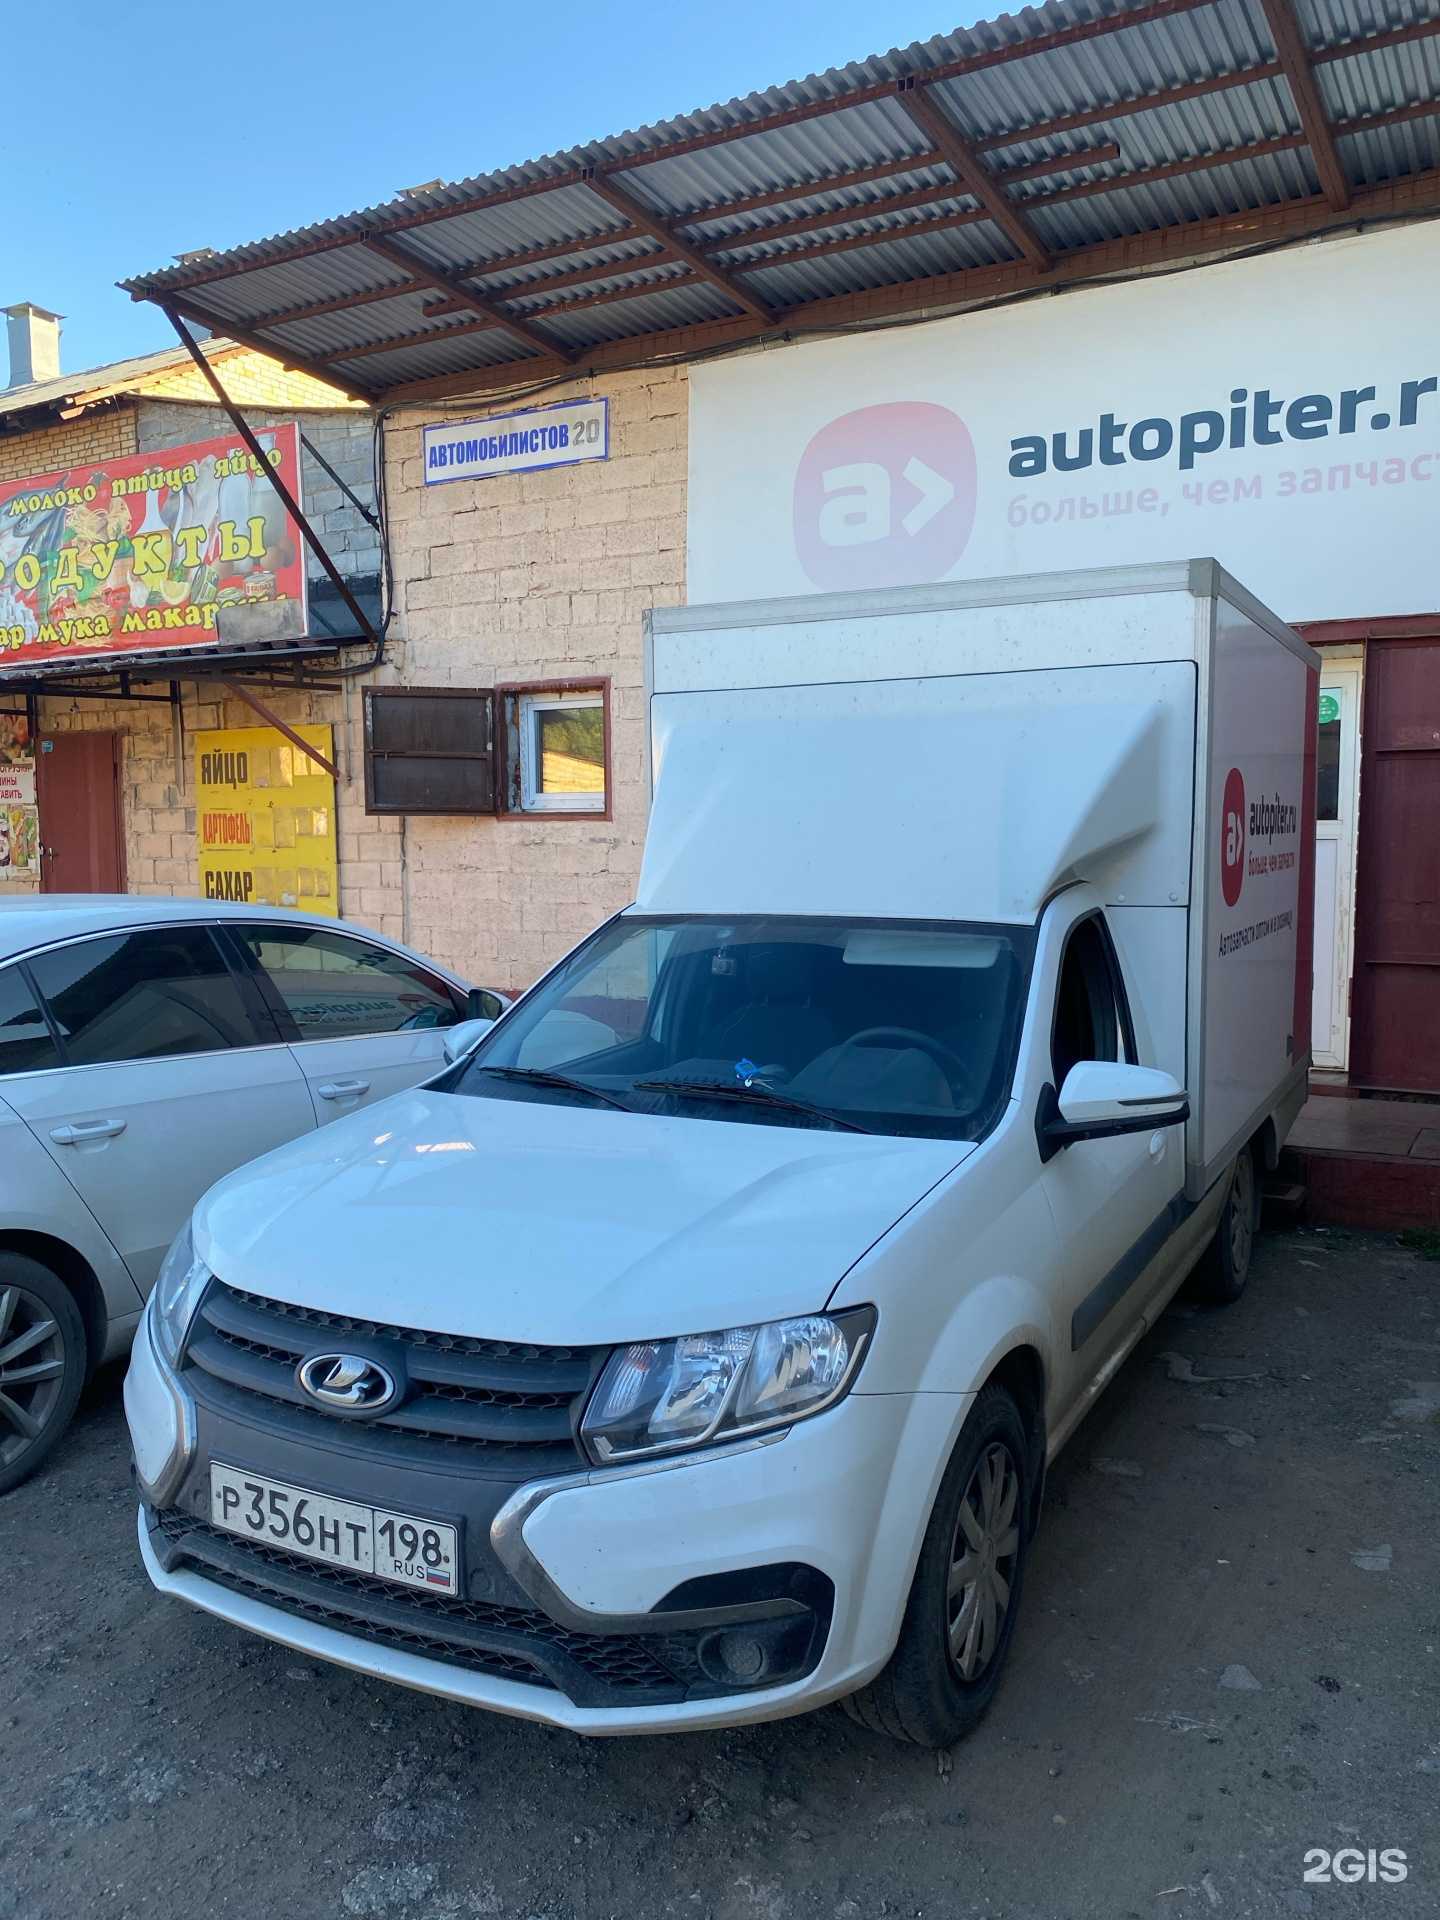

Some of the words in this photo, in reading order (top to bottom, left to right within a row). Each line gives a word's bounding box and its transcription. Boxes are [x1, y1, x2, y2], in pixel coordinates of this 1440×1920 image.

[429, 424, 568, 468] АВТОМОБИЛИСТОВ
[572, 418, 600, 446] 20
[1008, 377, 1437, 478] autopiter.r
[9, 485, 97, 517] молоко
[111, 462, 197, 496] птица
[1007, 487, 1169, 528] больше,
[1181, 474, 1263, 507] чем
[1277, 453, 1440, 497] запчас
[0, 516, 268, 595] ОДУКТЫ
[36, 615, 112, 646] мука
[0, 789, 23, 799] АВИТЬ
[201, 749, 248, 790] ЯЙЦО
[203, 813, 251, 845] КАРТОФЕЛЬ
[1249, 792, 1297, 845] autopiter.ru
[205, 870, 253, 902] САХАР
[222, 1482, 366, 1561] Р356НТ
[379, 1519, 442, 1568] 198
[394, 1560, 425, 1579] RUS
